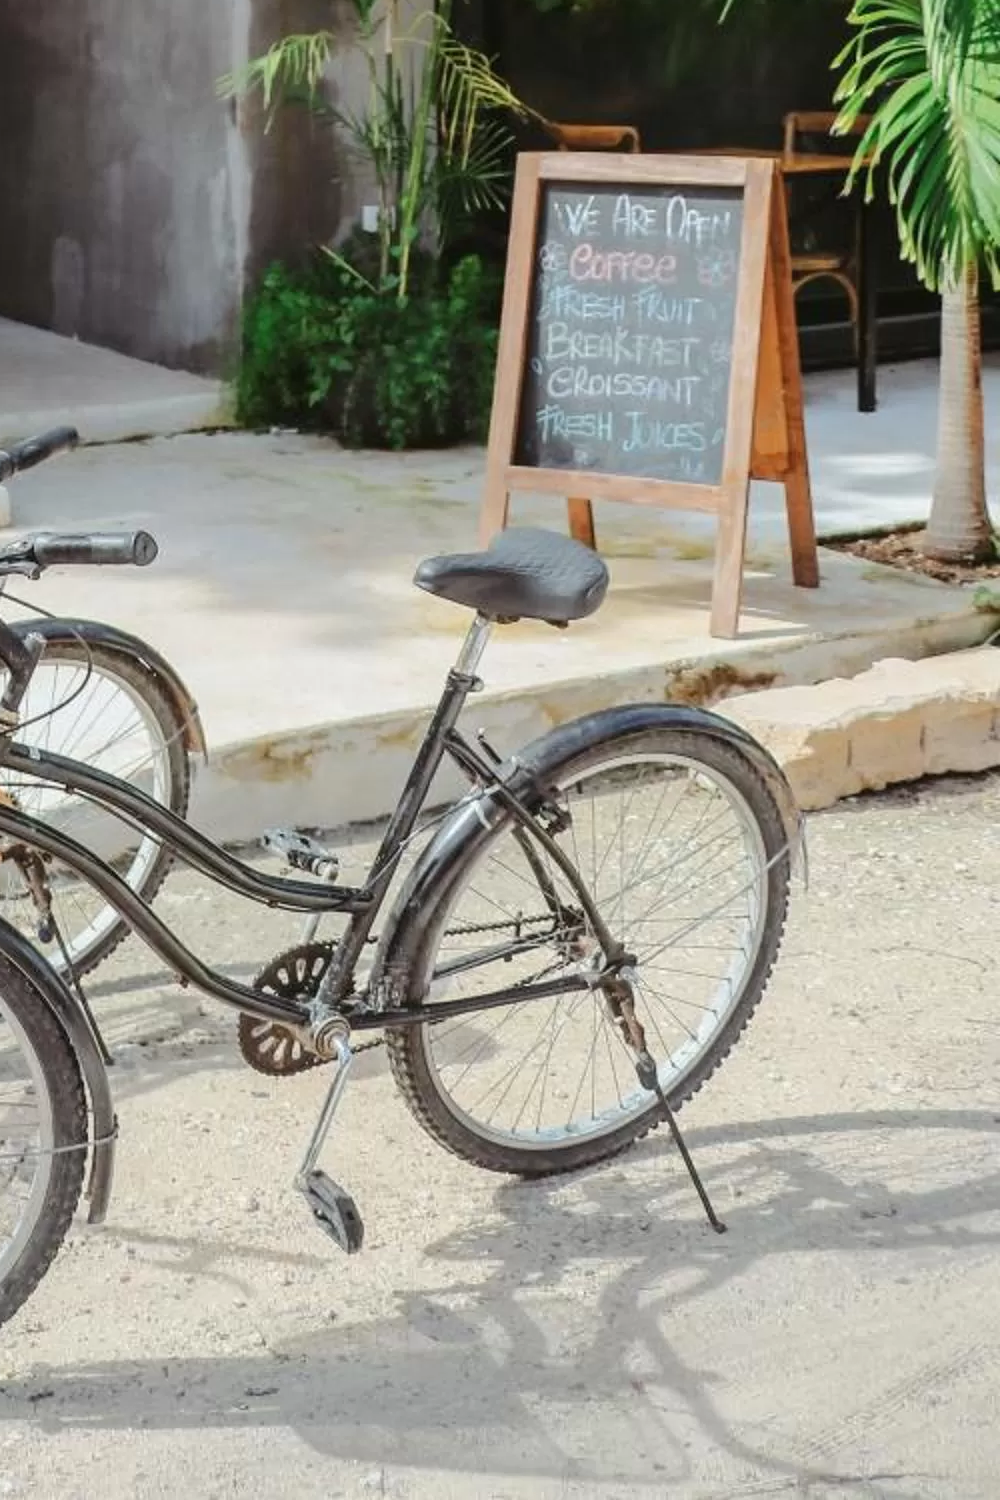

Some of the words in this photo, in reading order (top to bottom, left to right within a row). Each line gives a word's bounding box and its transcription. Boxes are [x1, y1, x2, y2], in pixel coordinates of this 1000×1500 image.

[553, 195, 600, 237] WE
[611, 193, 657, 237] ARE
[666, 195, 731, 246] OPEN
[568, 243, 678, 285] Coffee
[549, 284, 626, 322] FRESH
[631, 284, 704, 329] FRUIT
[545, 321, 702, 368] BREAKFAST
[547, 366, 702, 405] CROISSANT
[535, 403, 613, 444] FRESH
[622, 411, 707, 451] JUICES
